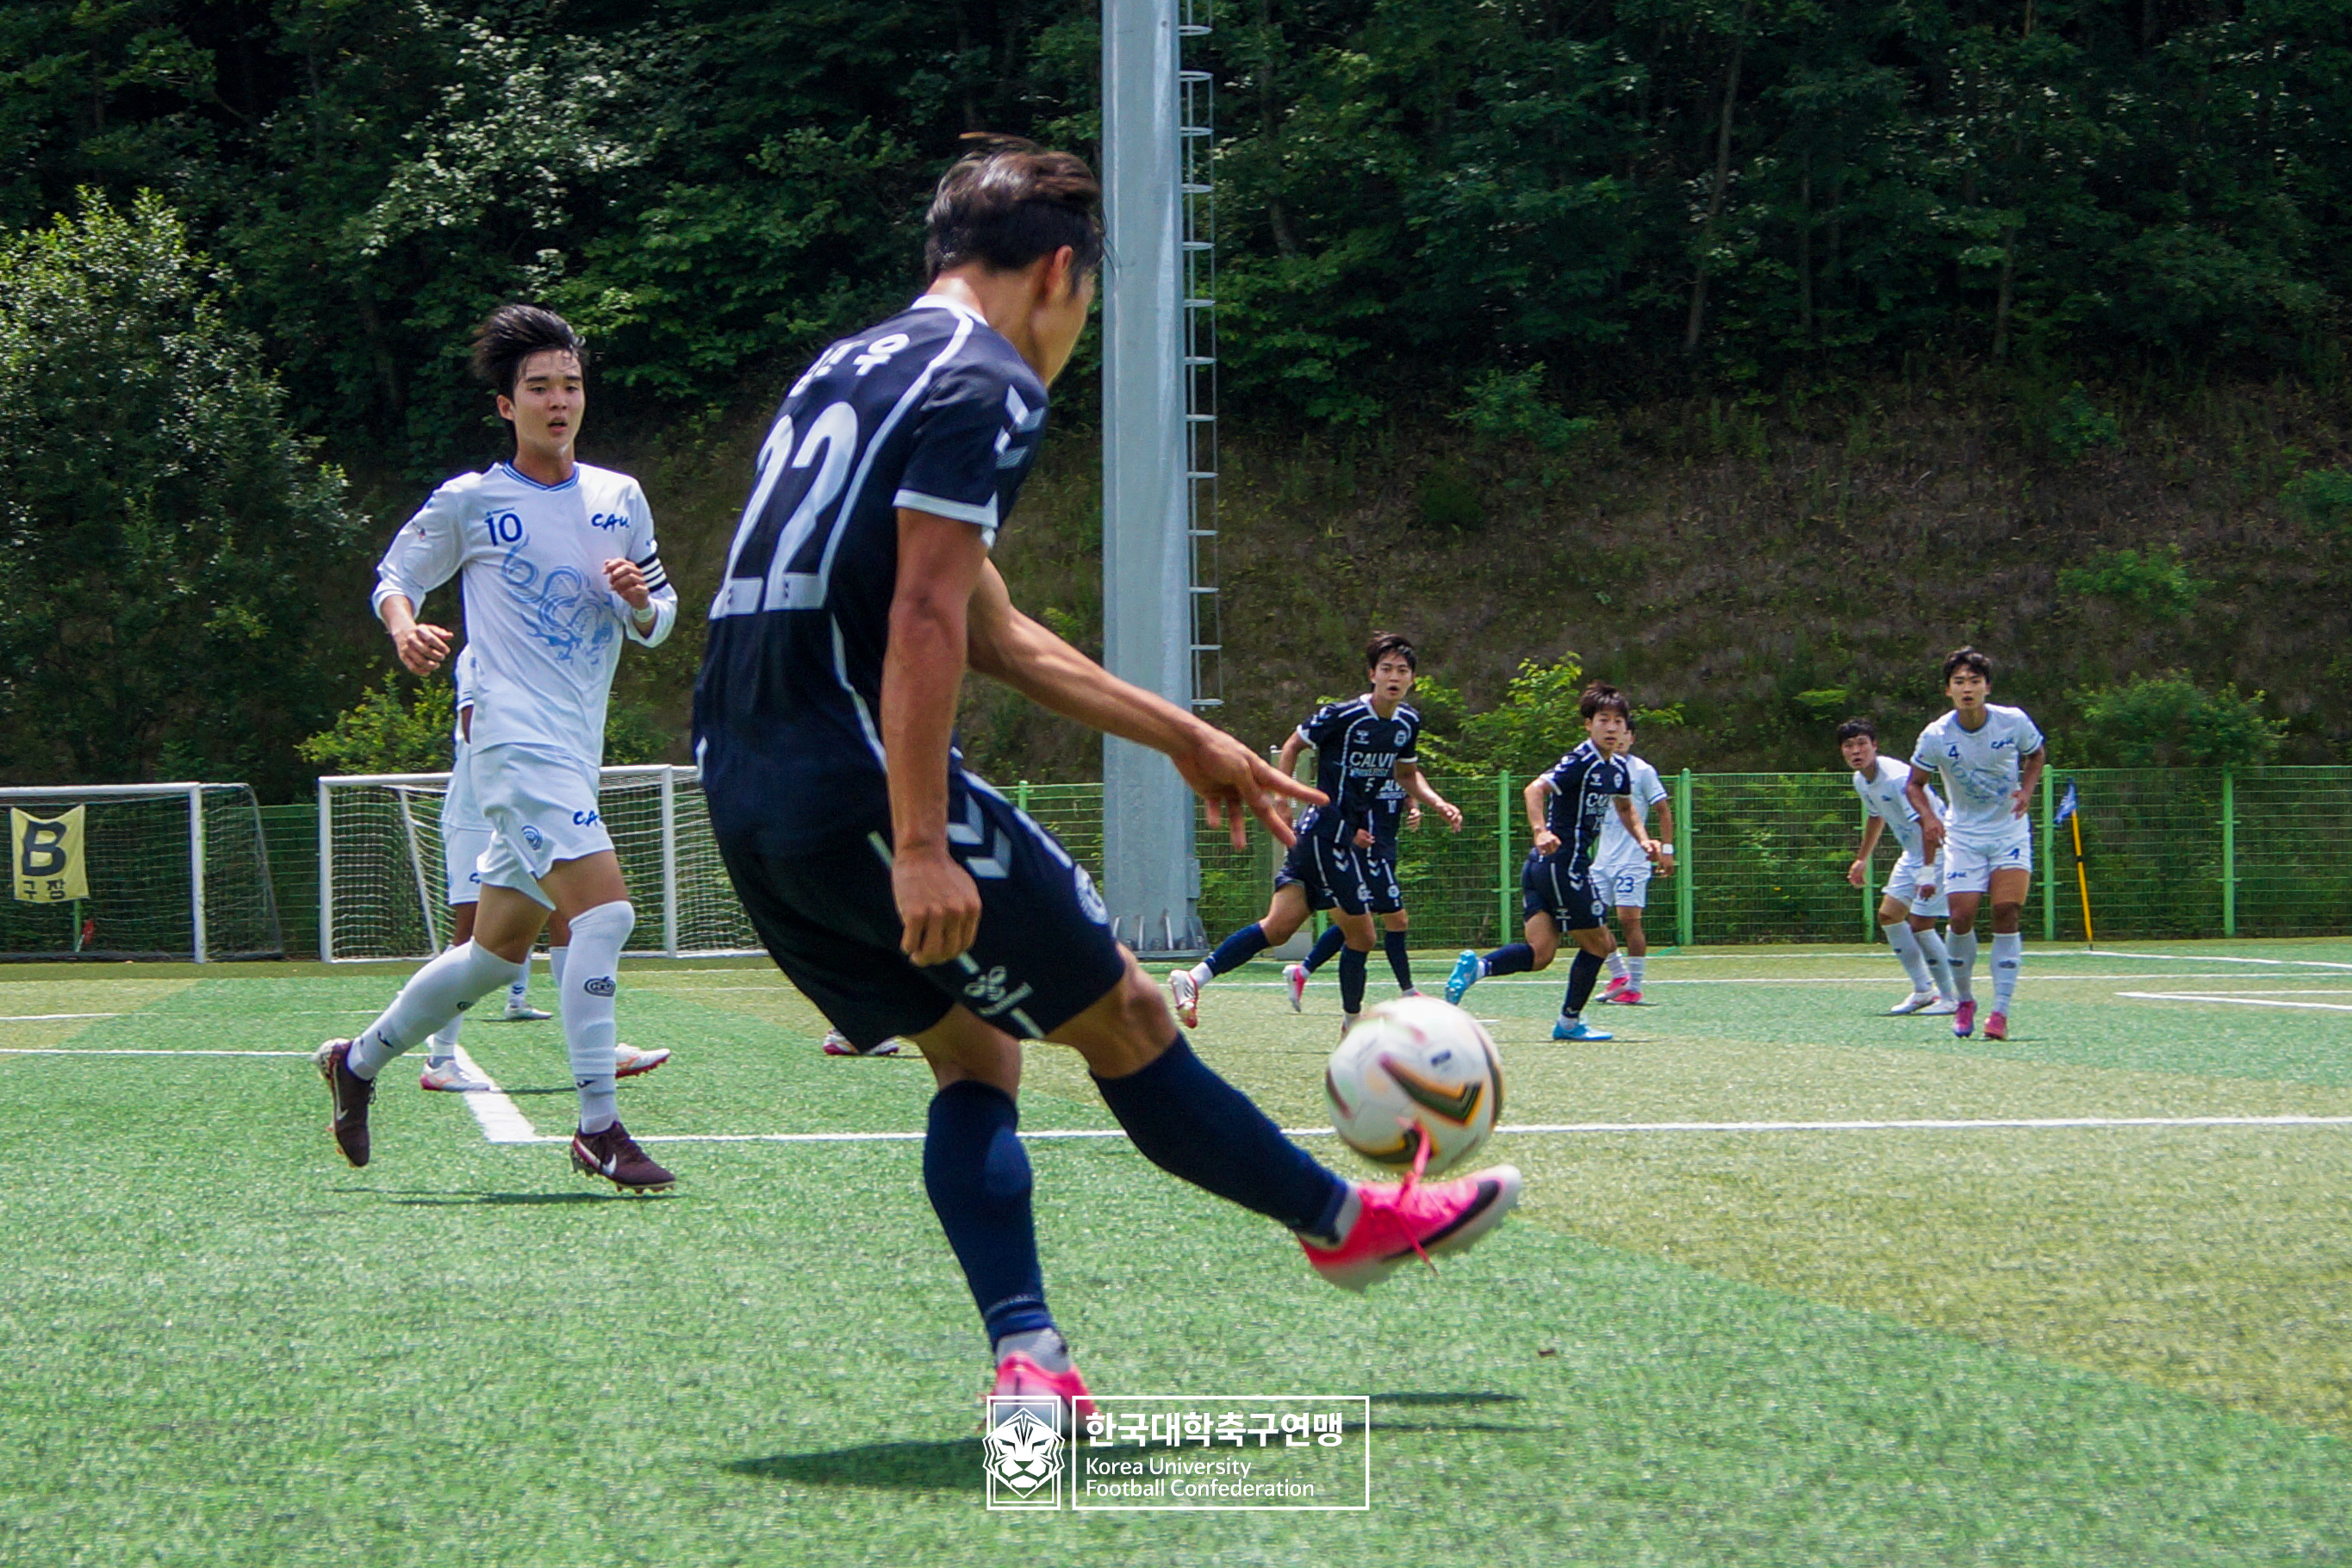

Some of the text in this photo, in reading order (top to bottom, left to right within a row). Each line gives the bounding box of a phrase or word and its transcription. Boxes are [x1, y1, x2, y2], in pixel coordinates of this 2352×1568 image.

[708, 401, 858, 620] 22
[484, 513, 523, 546] 10
[1948, 745, 1960, 760] 4
[573, 810, 605, 827] CA
[22, 820, 67, 877] B
[1616, 876, 1634, 893] 23
